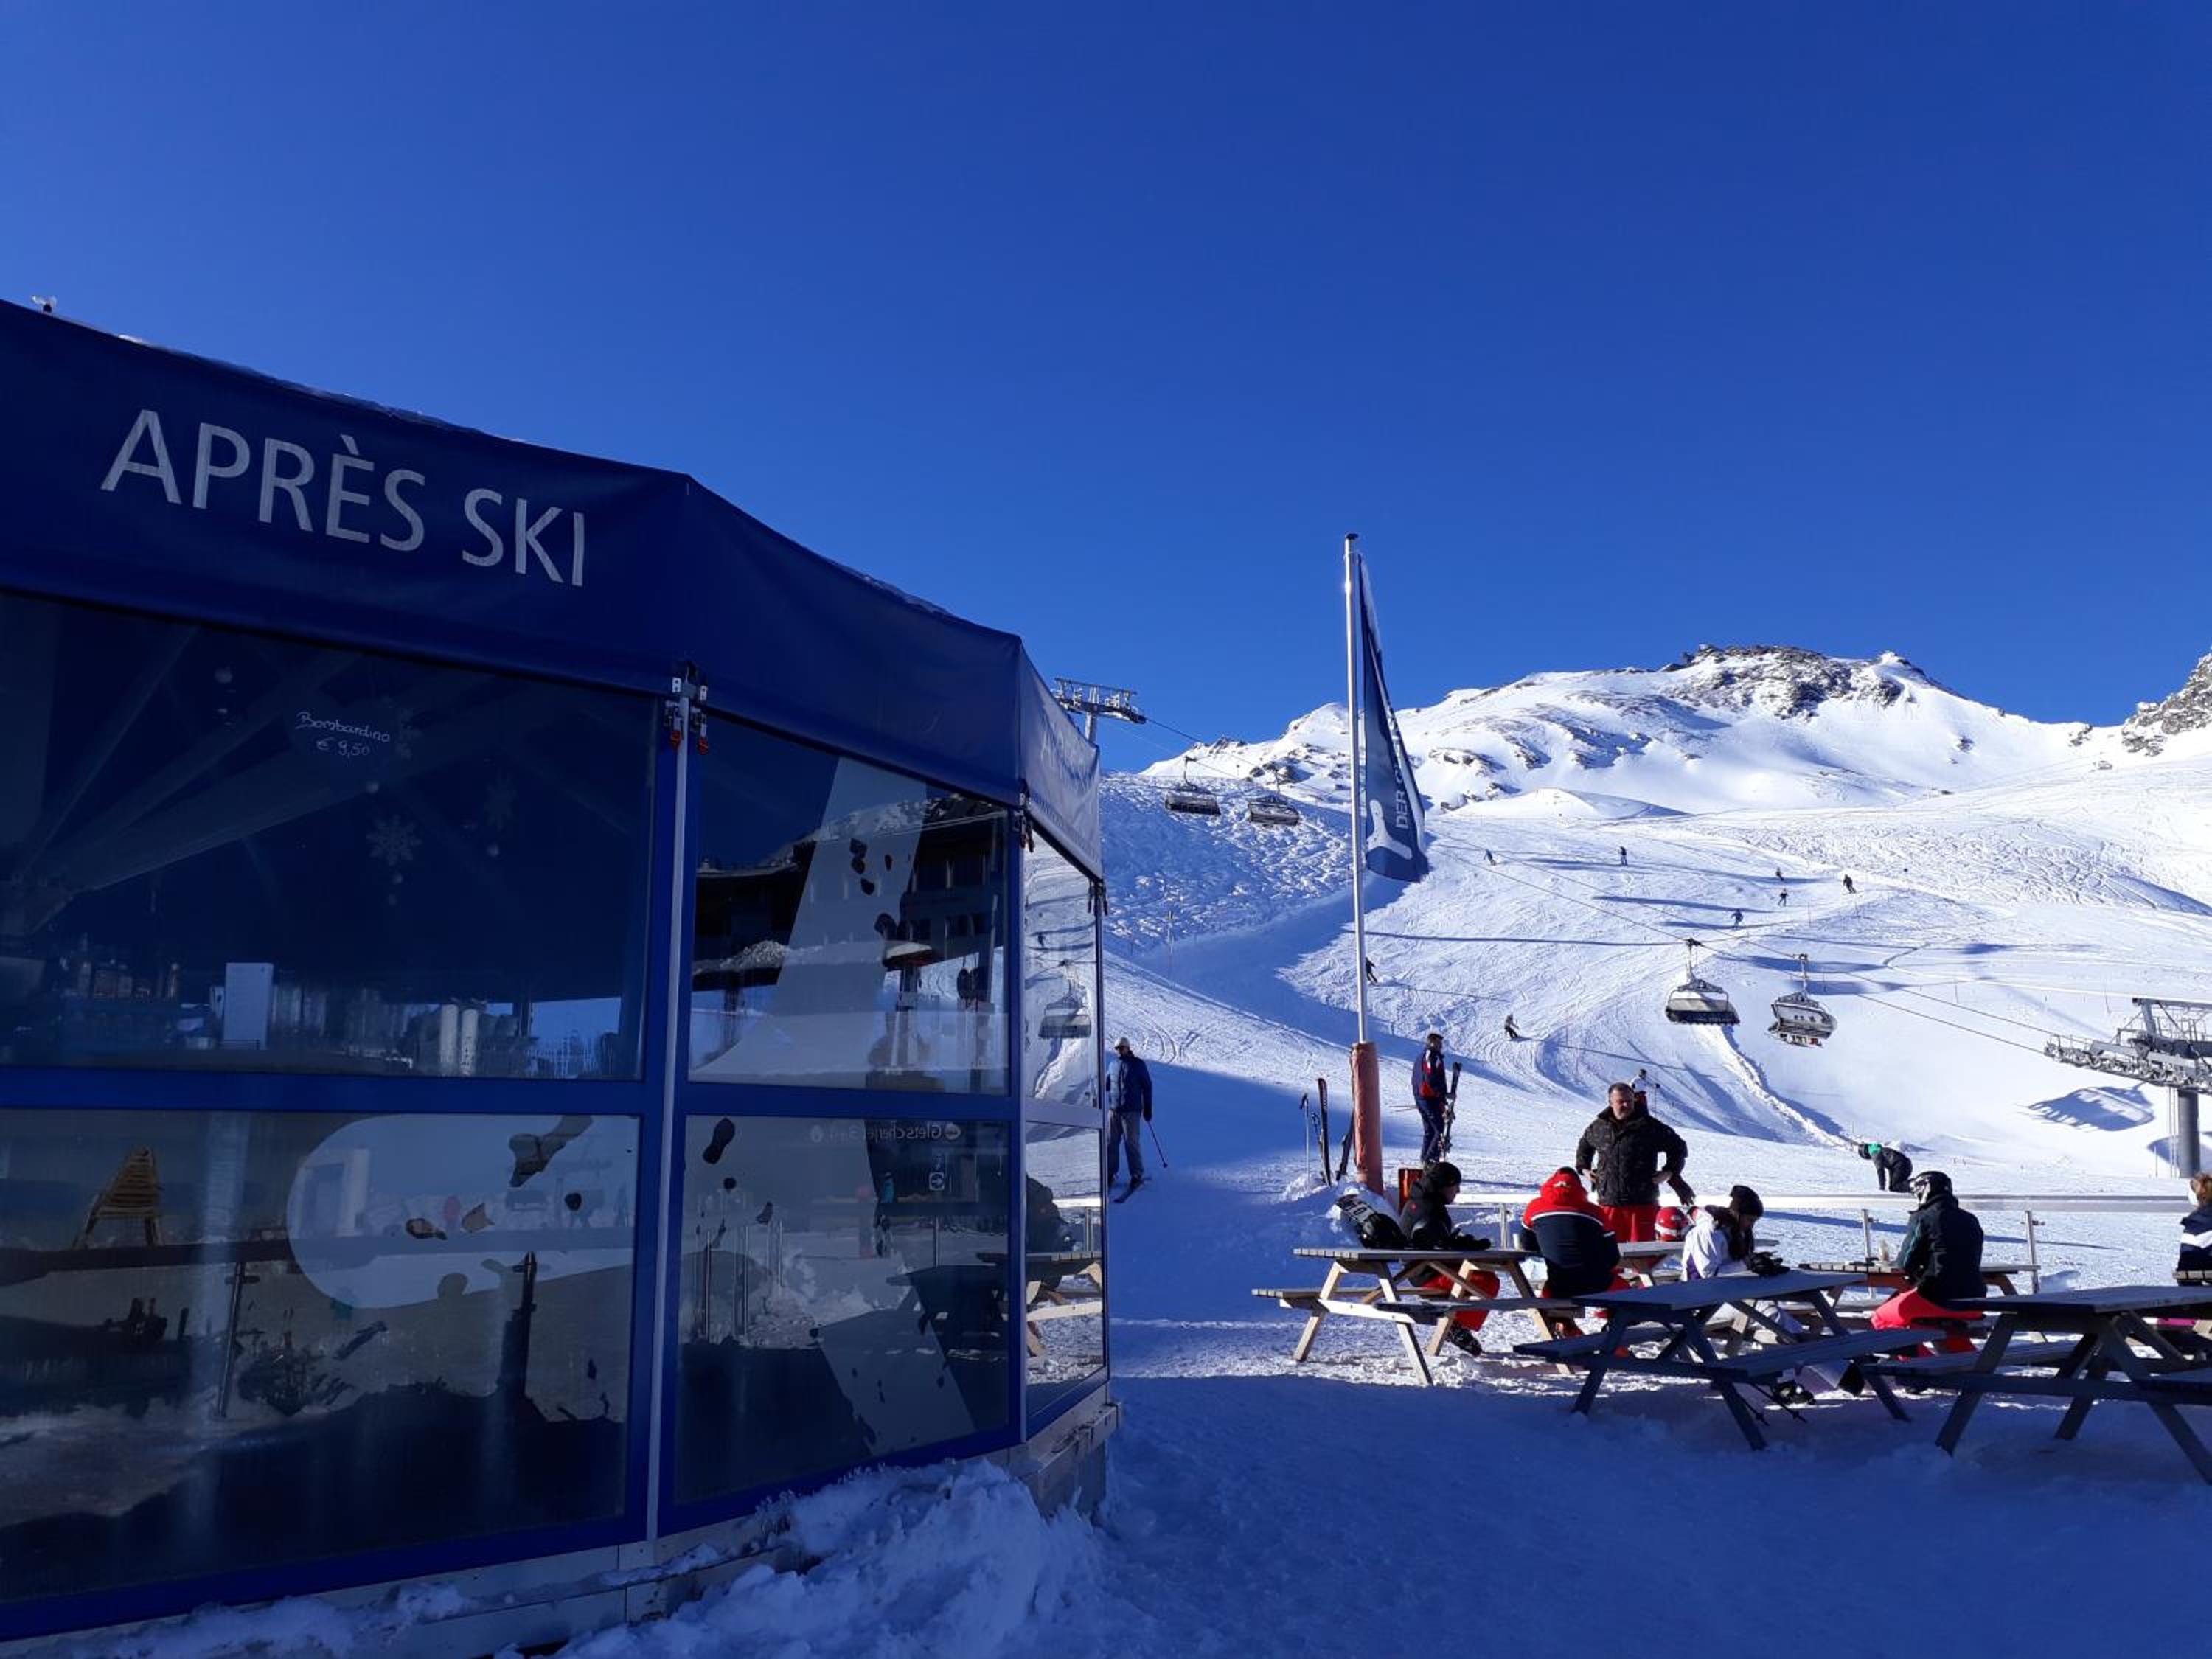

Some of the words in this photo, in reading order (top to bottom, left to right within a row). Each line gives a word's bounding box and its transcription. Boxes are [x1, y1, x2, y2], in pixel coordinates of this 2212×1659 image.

[100, 408, 425, 552] APRÈS
[462, 487, 586, 588] SKI
[295, 711, 390, 742] Bombardino
[1394, 790, 1409, 830] DER
